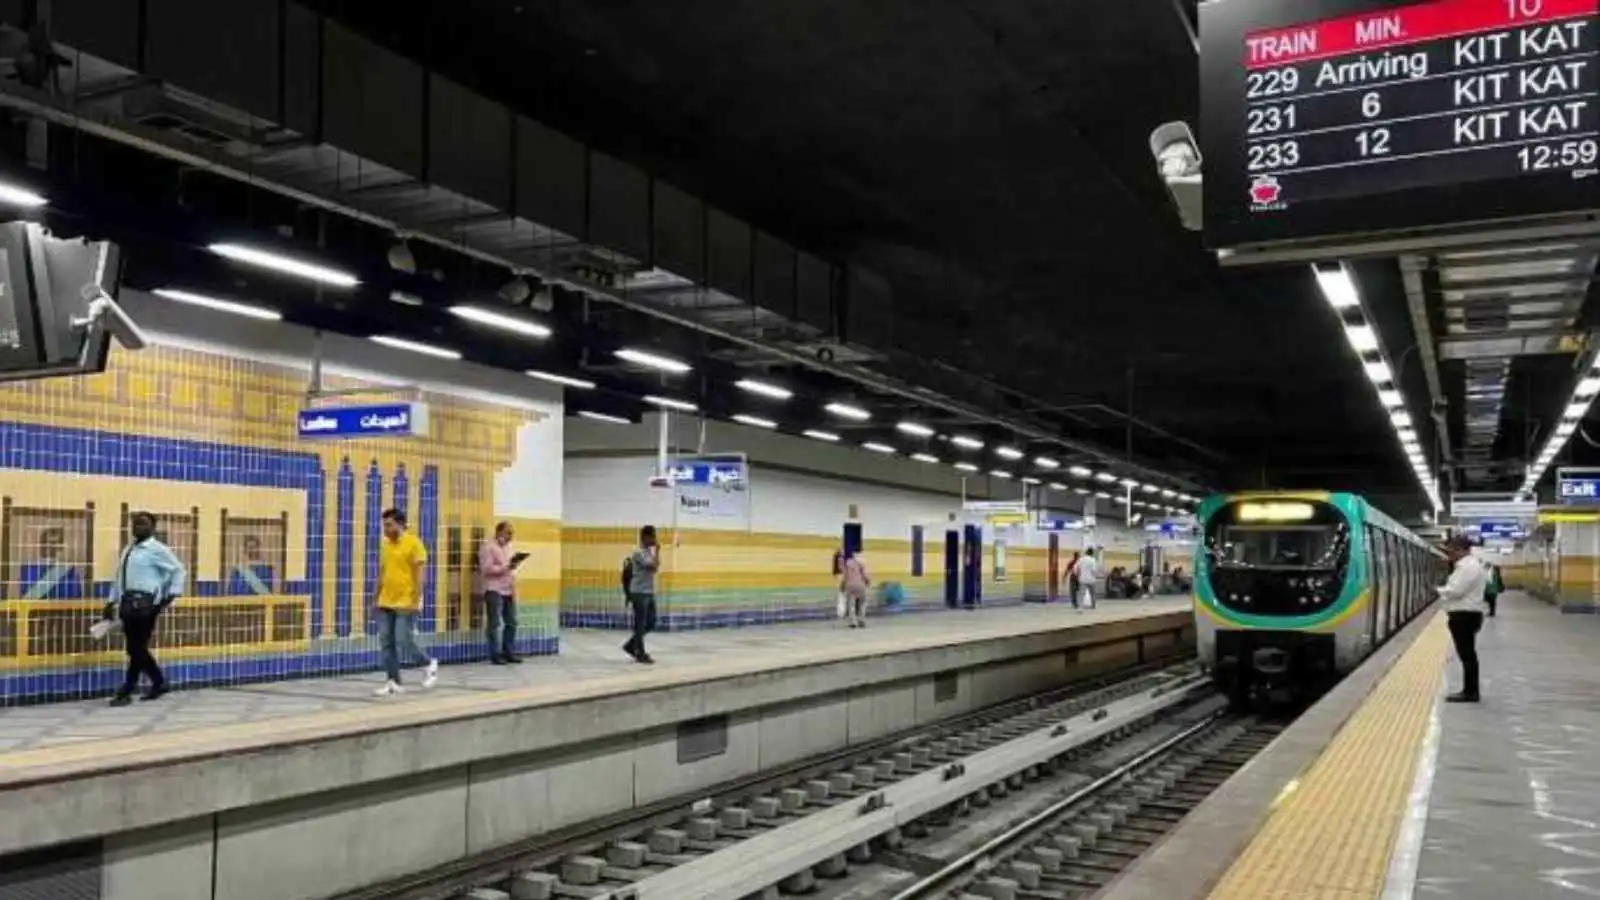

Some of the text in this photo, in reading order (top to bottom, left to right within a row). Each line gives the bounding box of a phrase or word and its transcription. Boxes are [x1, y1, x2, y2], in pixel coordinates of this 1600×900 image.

[1247, 28, 1317, 61] TRAIN
[1355, 16, 1407, 44] MIN.
[1247, 21, 1588, 98] 229 Arriving KIT KAT
[1247, 61, 1587, 134] 231 6 KIT KAT
[1247, 101, 1587, 170] 233 12 KIT KAT
[1517, 139, 1598, 171] 12:59
[1562, 483, 1594, 496] Exit
